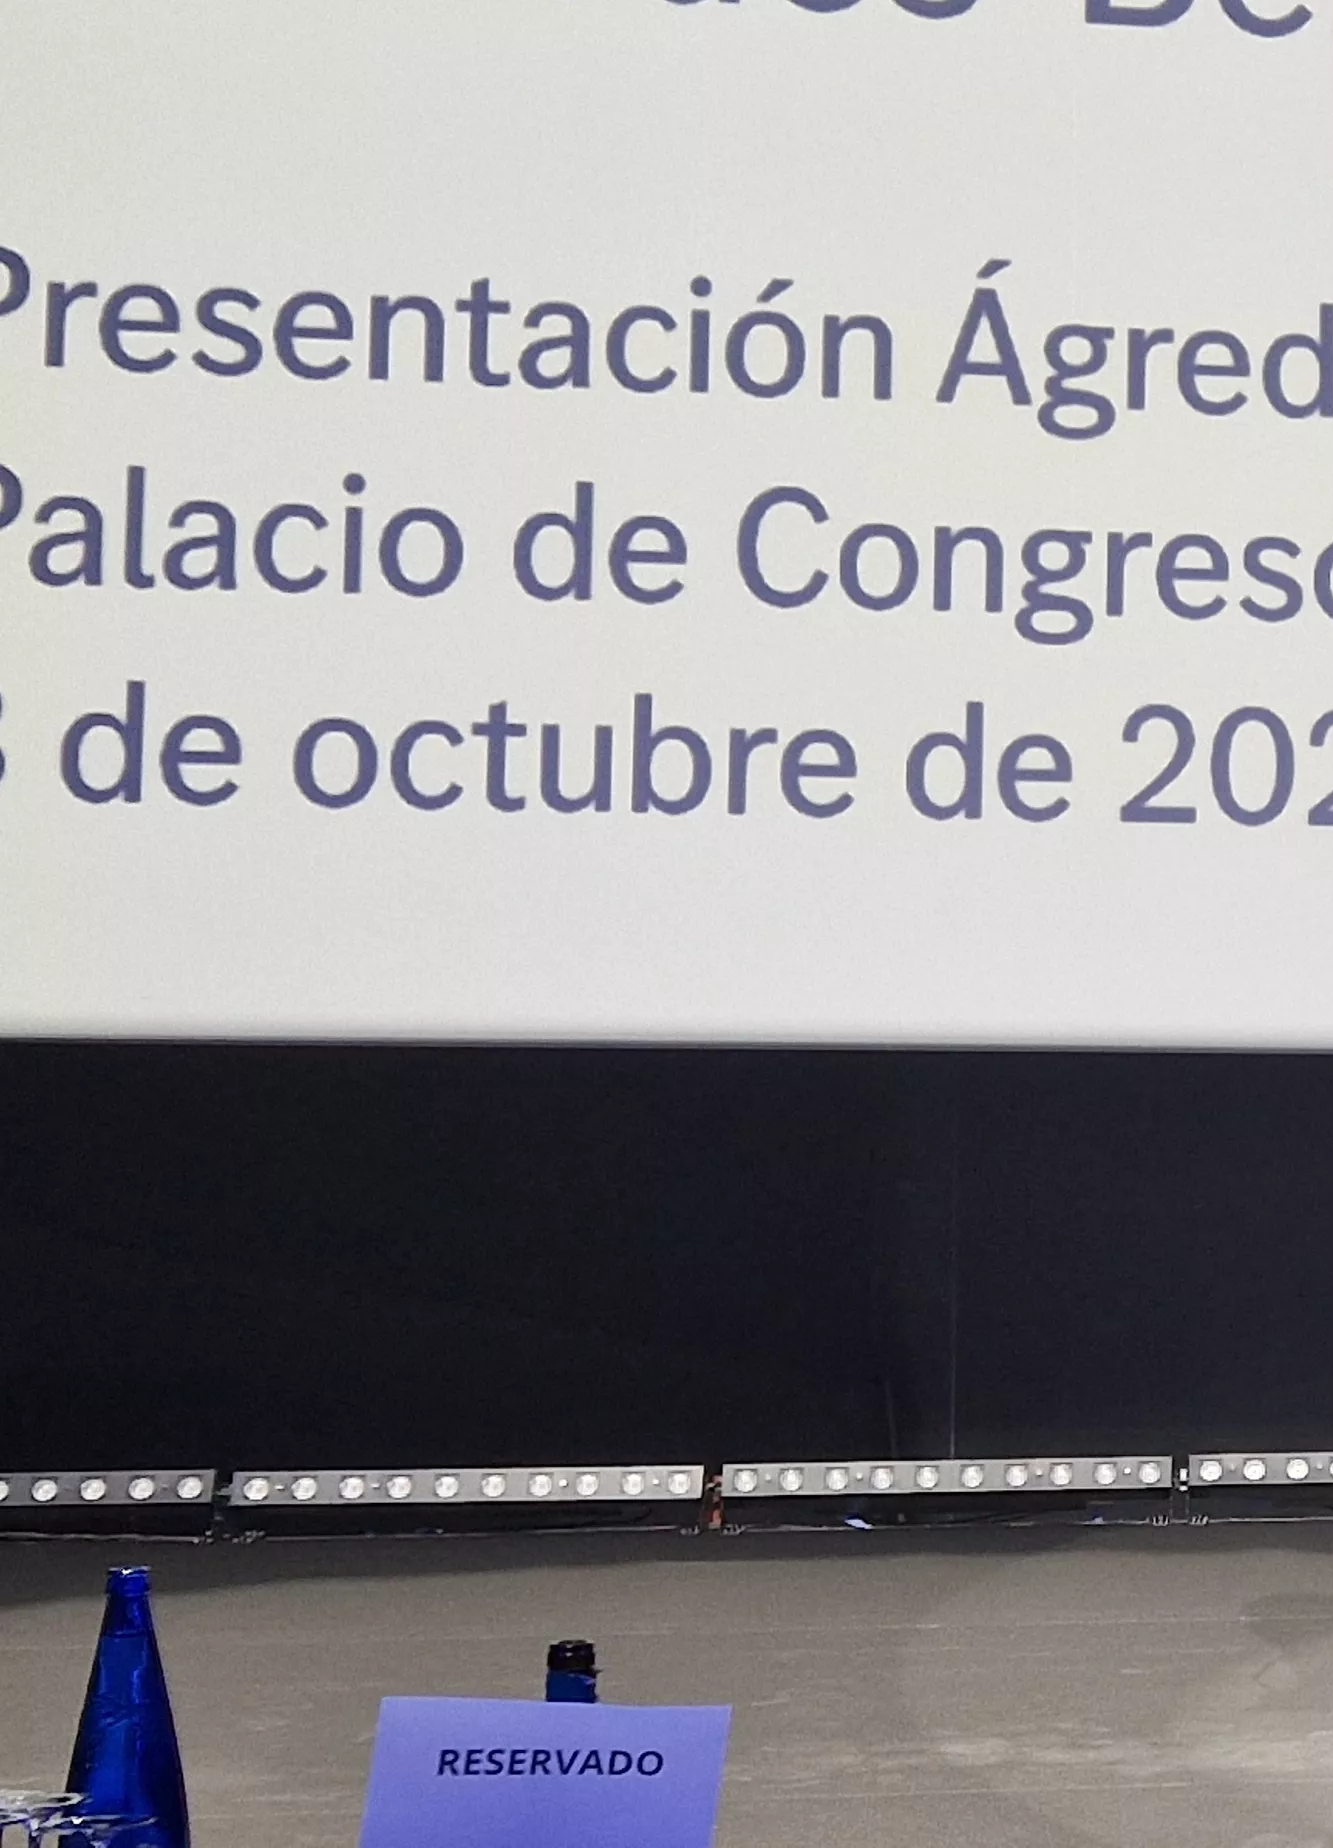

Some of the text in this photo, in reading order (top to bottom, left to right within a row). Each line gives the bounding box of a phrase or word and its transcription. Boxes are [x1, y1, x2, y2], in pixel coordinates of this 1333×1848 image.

[0, 463, 464, 598] alacio
[513, 480, 688, 605] de
[60, 679, 243, 807] de
[292, 692, 858, 819] octubre
[905, 700, 1073, 823] de
[437, 1748, 664, 1777] RESERVADO
